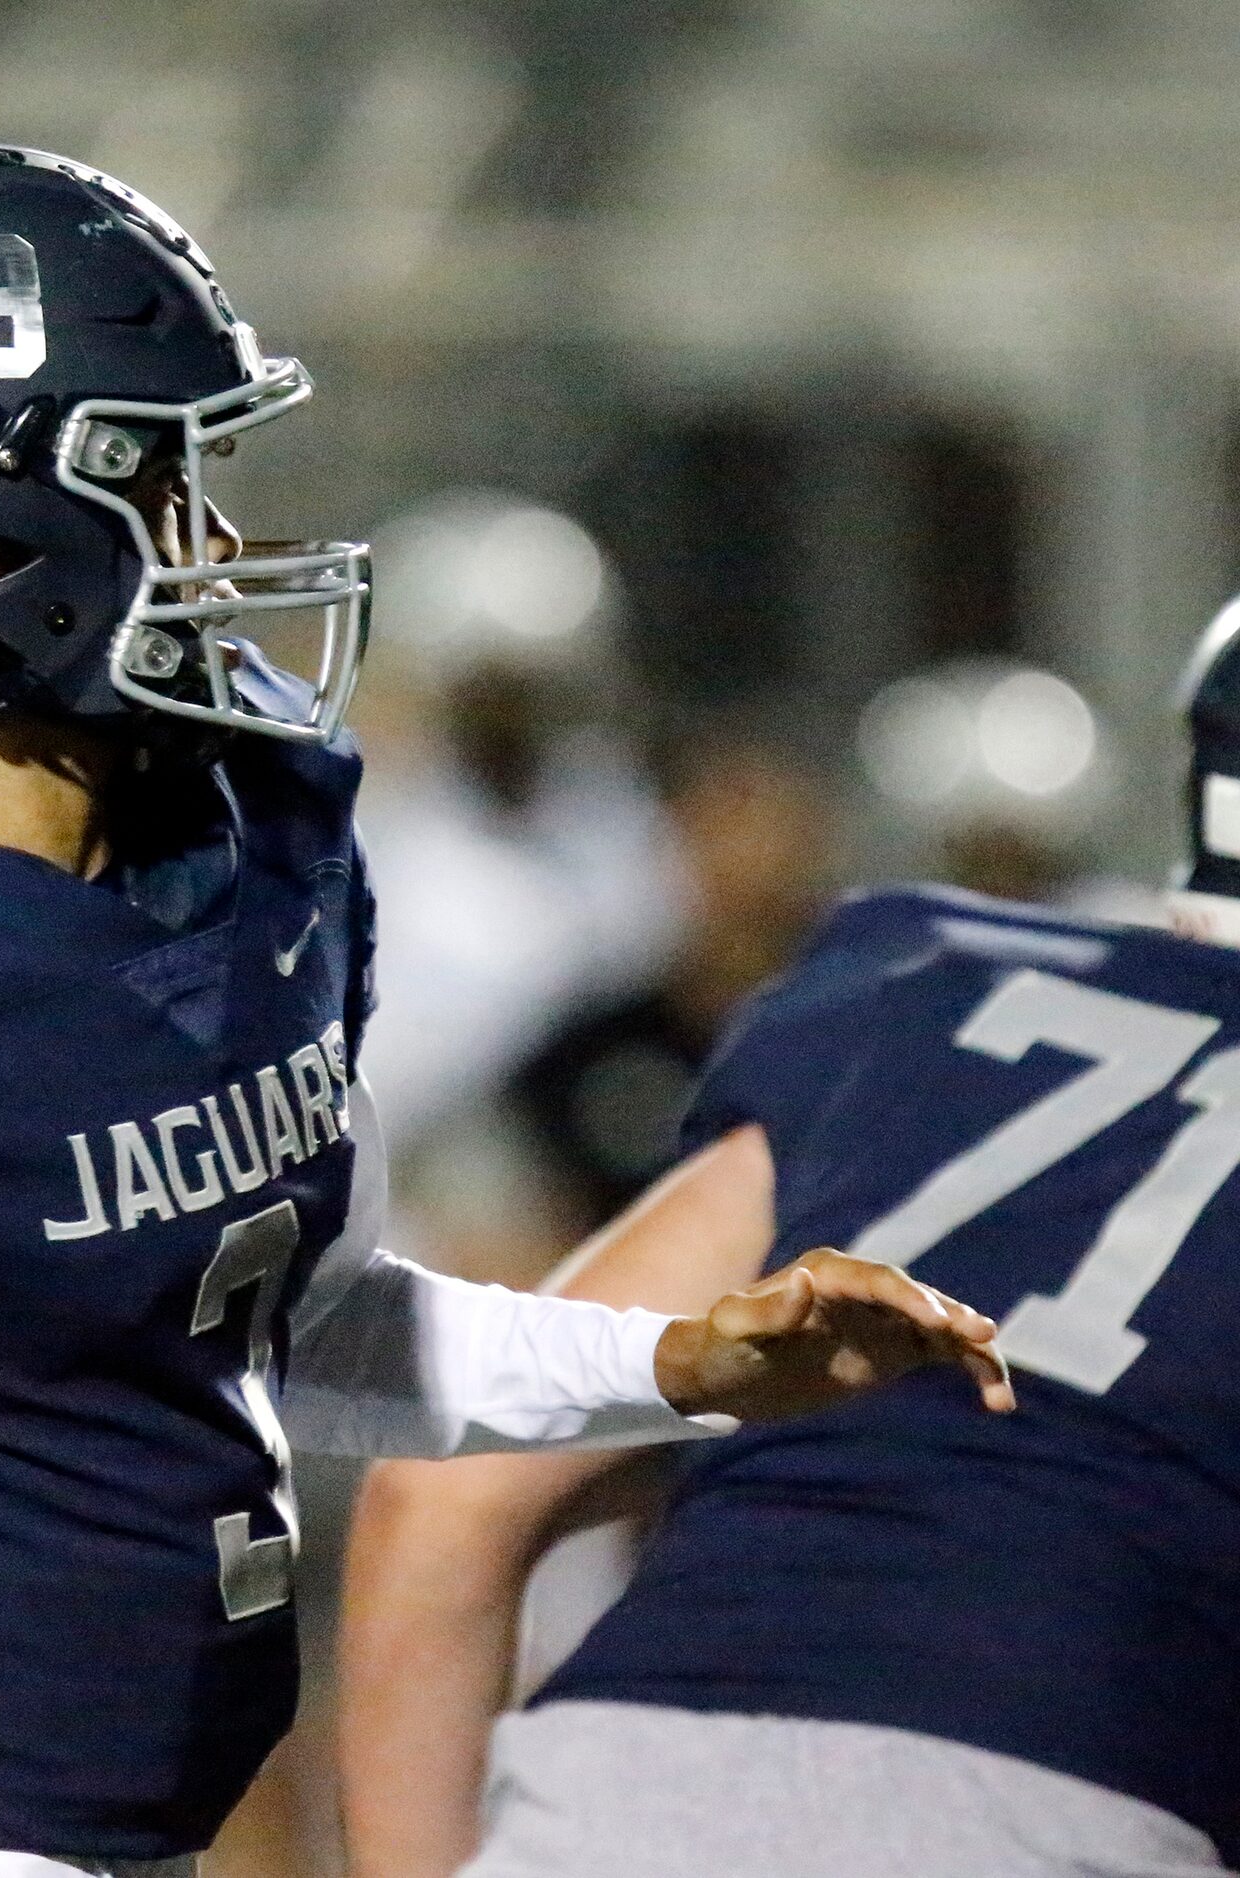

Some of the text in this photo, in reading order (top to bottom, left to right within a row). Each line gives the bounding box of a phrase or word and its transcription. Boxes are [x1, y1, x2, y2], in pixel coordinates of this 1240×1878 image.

[43, 1020, 350, 1241] JAGUARS
[848, 968, 1240, 1396] 71
[189, 1200, 301, 1621] 3
